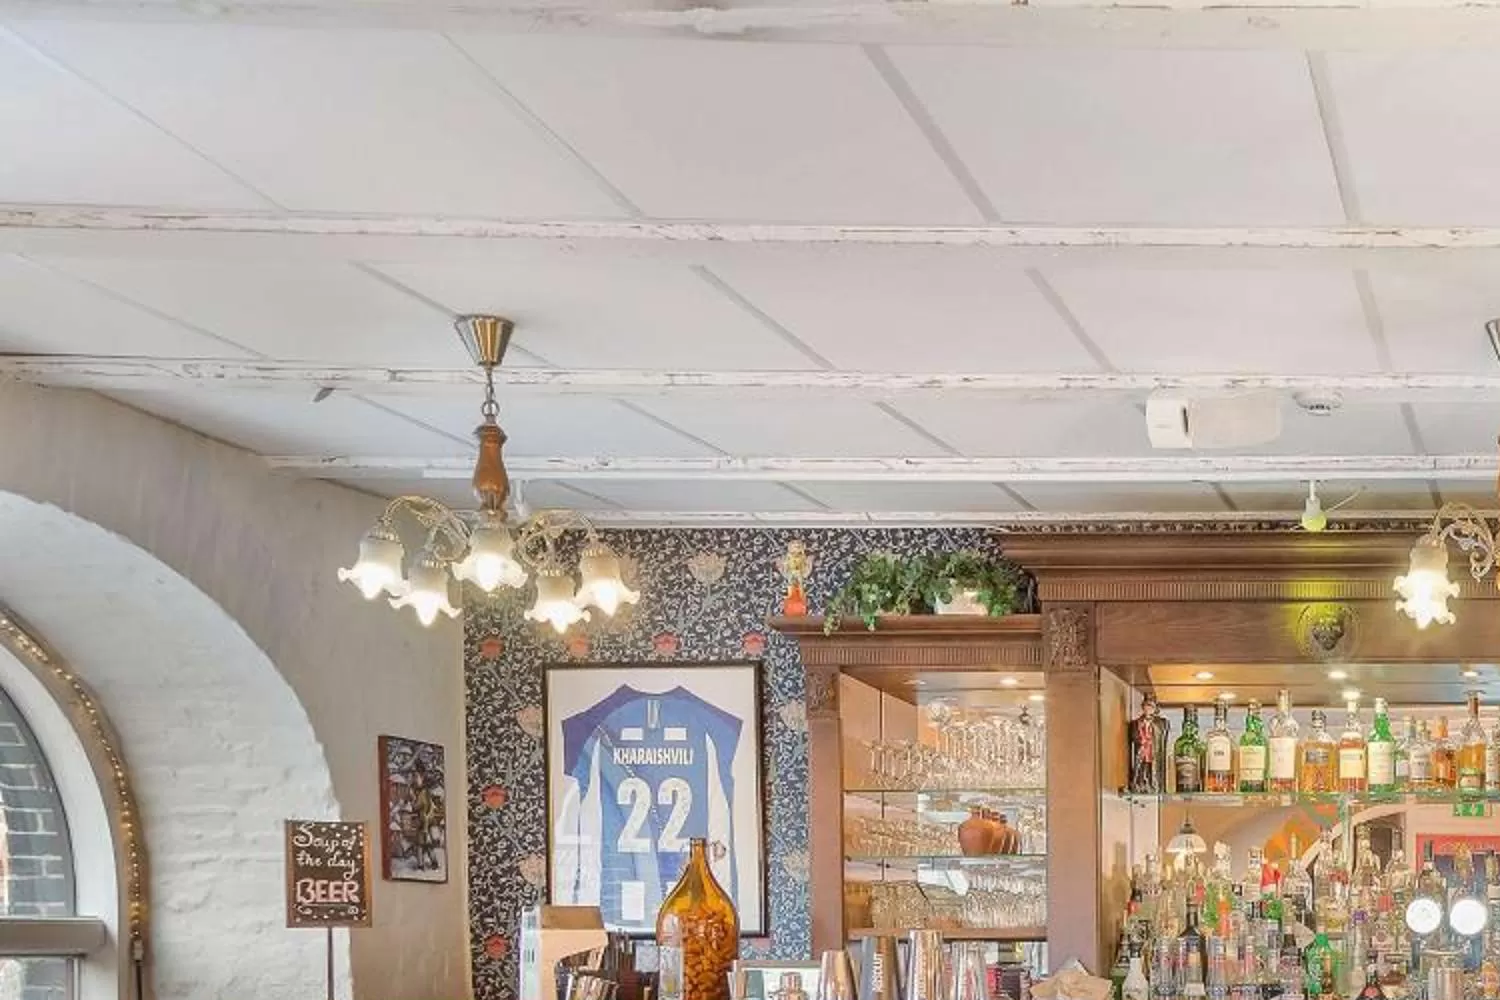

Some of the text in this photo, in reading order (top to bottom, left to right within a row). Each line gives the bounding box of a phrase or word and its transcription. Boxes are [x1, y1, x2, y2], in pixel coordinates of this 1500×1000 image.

[613, 747, 695, 765] KHARAISHVILI
[616, 777, 692, 853] 22
[293, 823, 339, 852] Soup
[296, 850, 355, 880] the day
[296, 878, 361, 904] BEER
